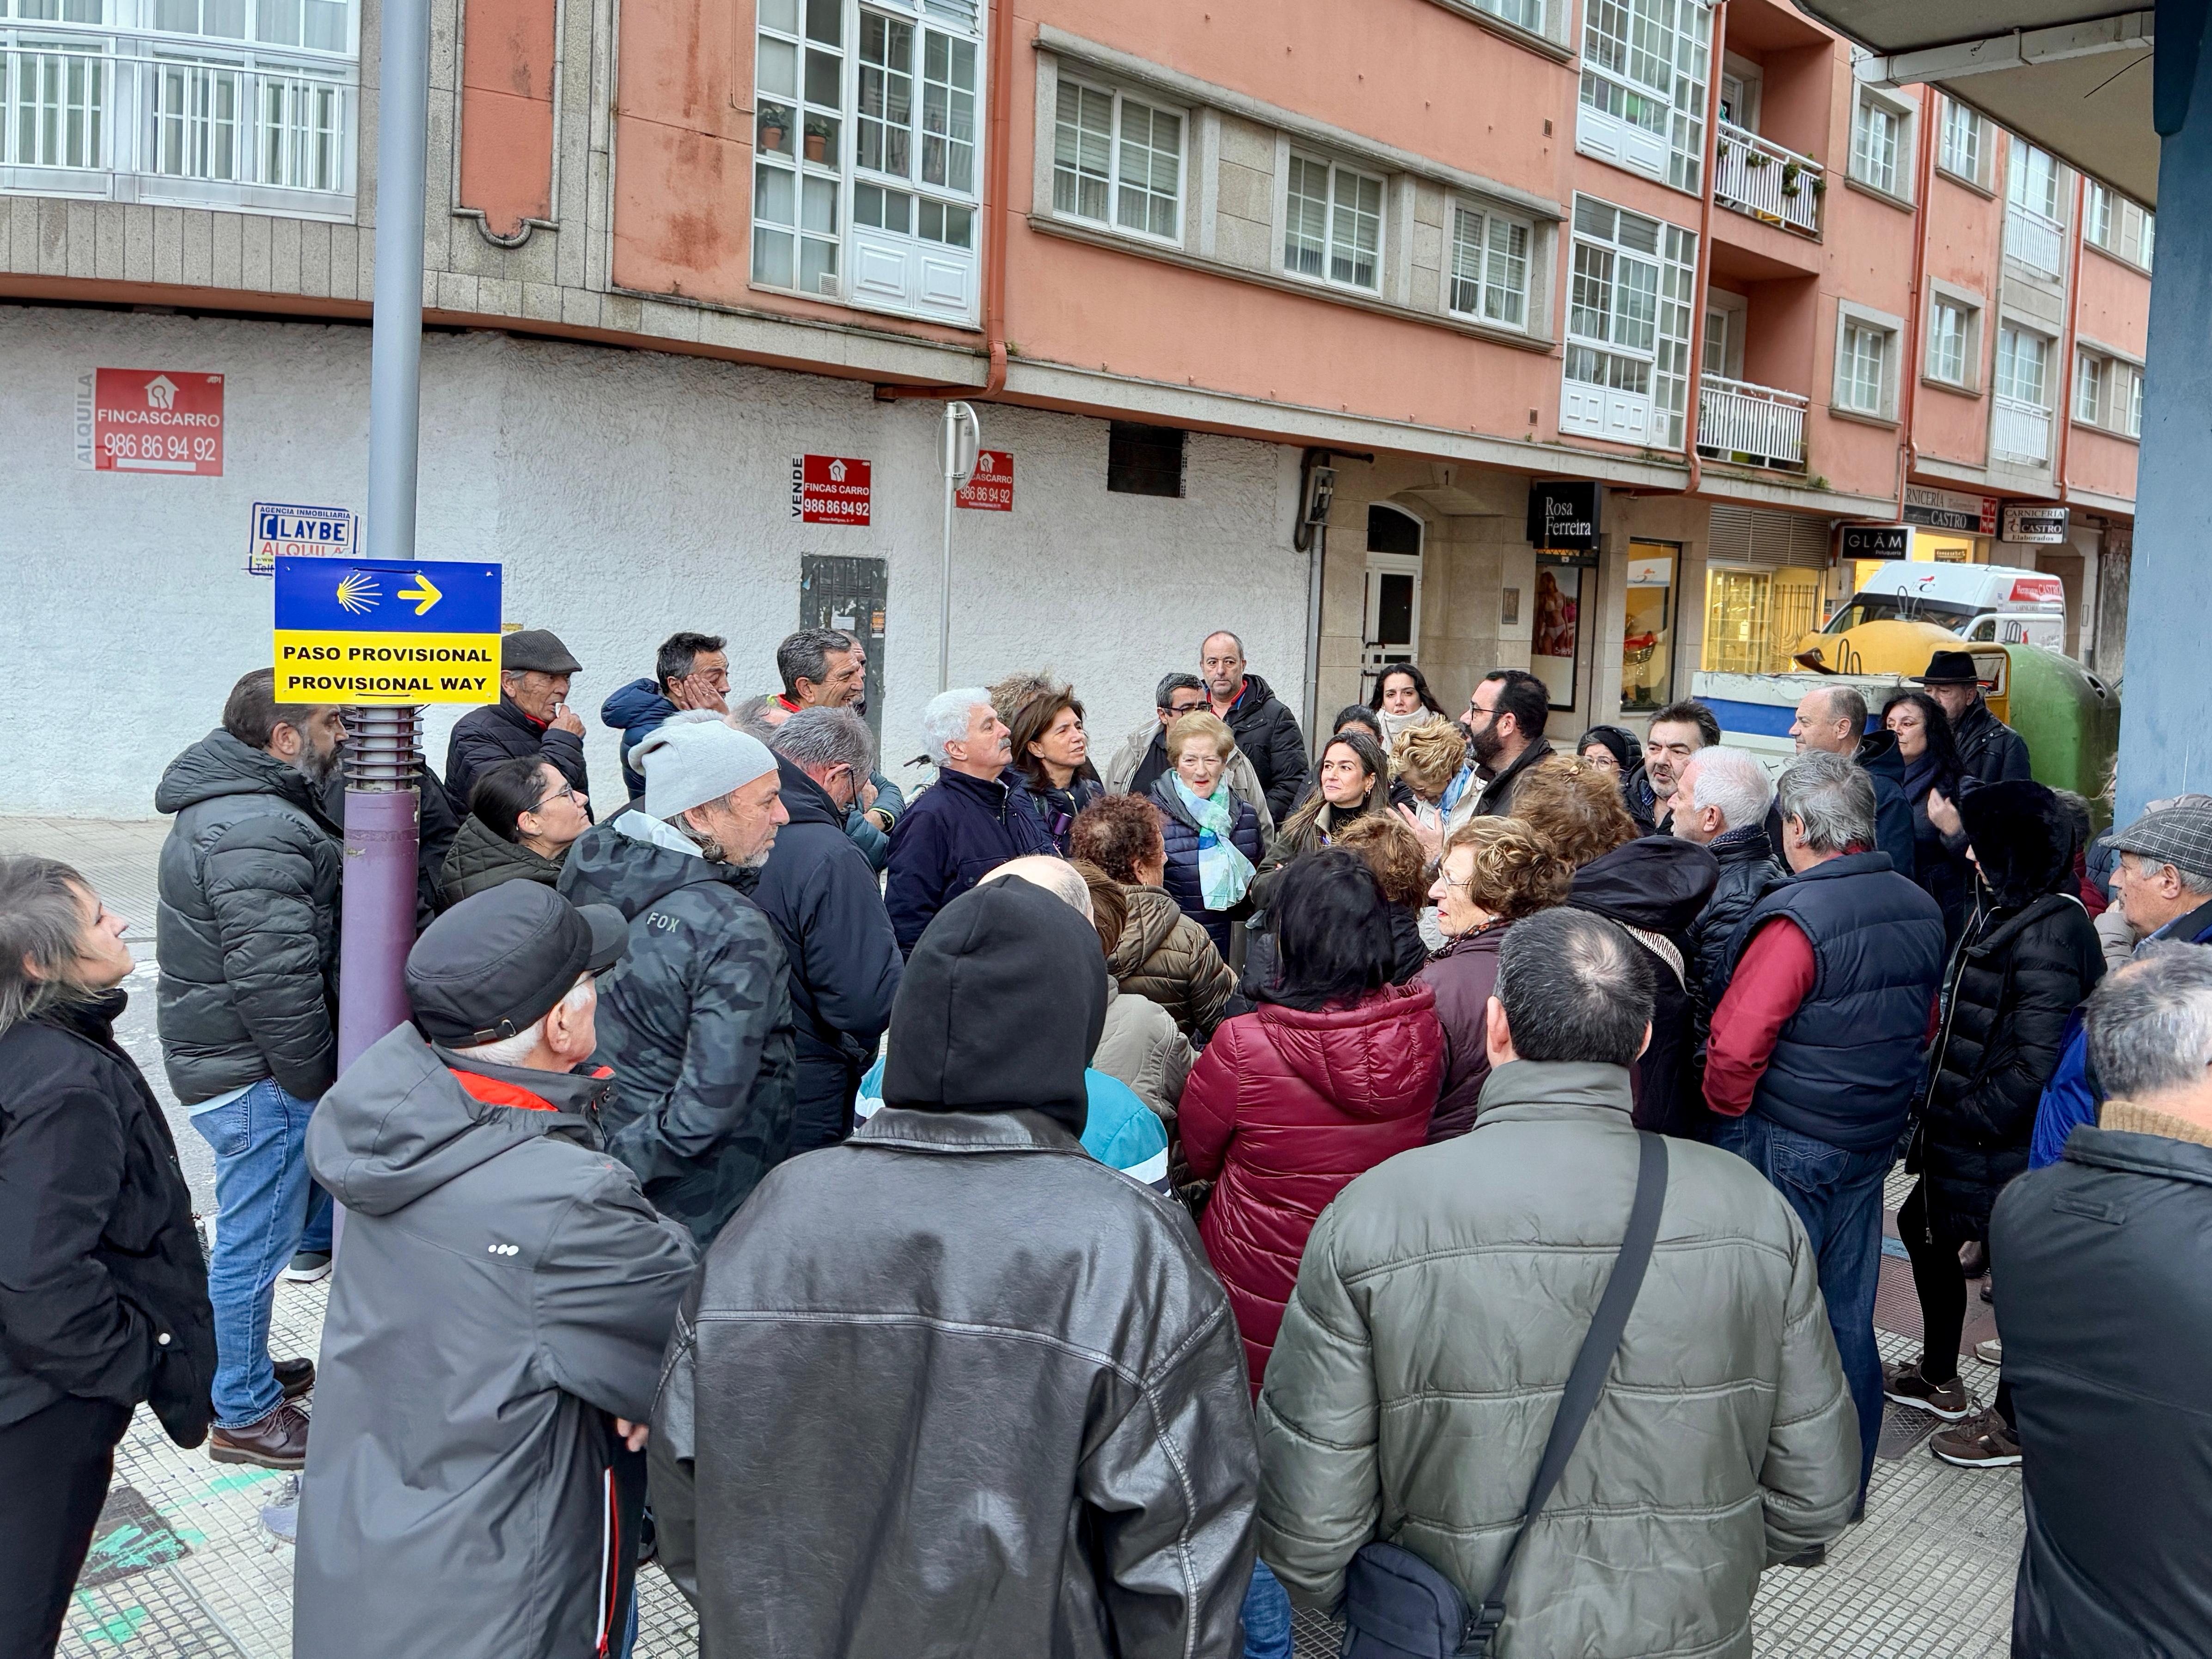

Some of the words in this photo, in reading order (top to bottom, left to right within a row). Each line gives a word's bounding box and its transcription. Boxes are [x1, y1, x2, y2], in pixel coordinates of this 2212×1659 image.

[76, 374, 93, 465] ALQUILA
[104, 433, 137, 457] 986
[141, 434, 163, 458] 86
[167, 436, 189, 460] 94
[193, 437, 216, 461] 92
[1444, 470, 1449, 486] 1
[792, 458, 803, 517] VENDE
[805, 483, 837, 493] FINCAS
[839, 486, 869, 495] CARRO
[960, 486, 975, 500] 986
[977, 487, 987, 501] 86
[989, 488, 998, 502] 94
[1000, 489, 1010, 503] 92
[260, 506, 294, 515] AGENCIA
[297, 509, 351, 519] INMOBILIARIA
[804, 498, 825, 513] 986
[826, 500, 840, 514] 86
[841, 501, 855, 515] 94
[855, 502, 869, 516] 92
[1545, 497, 1573, 516] Rosa
[2005, 509, 2063, 518] CARNICERÍA
[262, 515, 346, 542] CLAYBE
[1545, 516, 1591, 536] Ferreira
[1931, 511, 1967, 529] CASTRO
[2022, 525, 2062, 533] CASTRO
[1849, 532, 1902, 549] GLÄM
[2038, 584, 2061, 595] CASTRO
[284, 647, 341, 660] PASO
[349, 648, 492, 662] PROVISIONAL
[288, 677, 433, 690] PROVISIONAL
[441, 678, 487, 690] WAY
[647, 912, 679, 933] FOX
